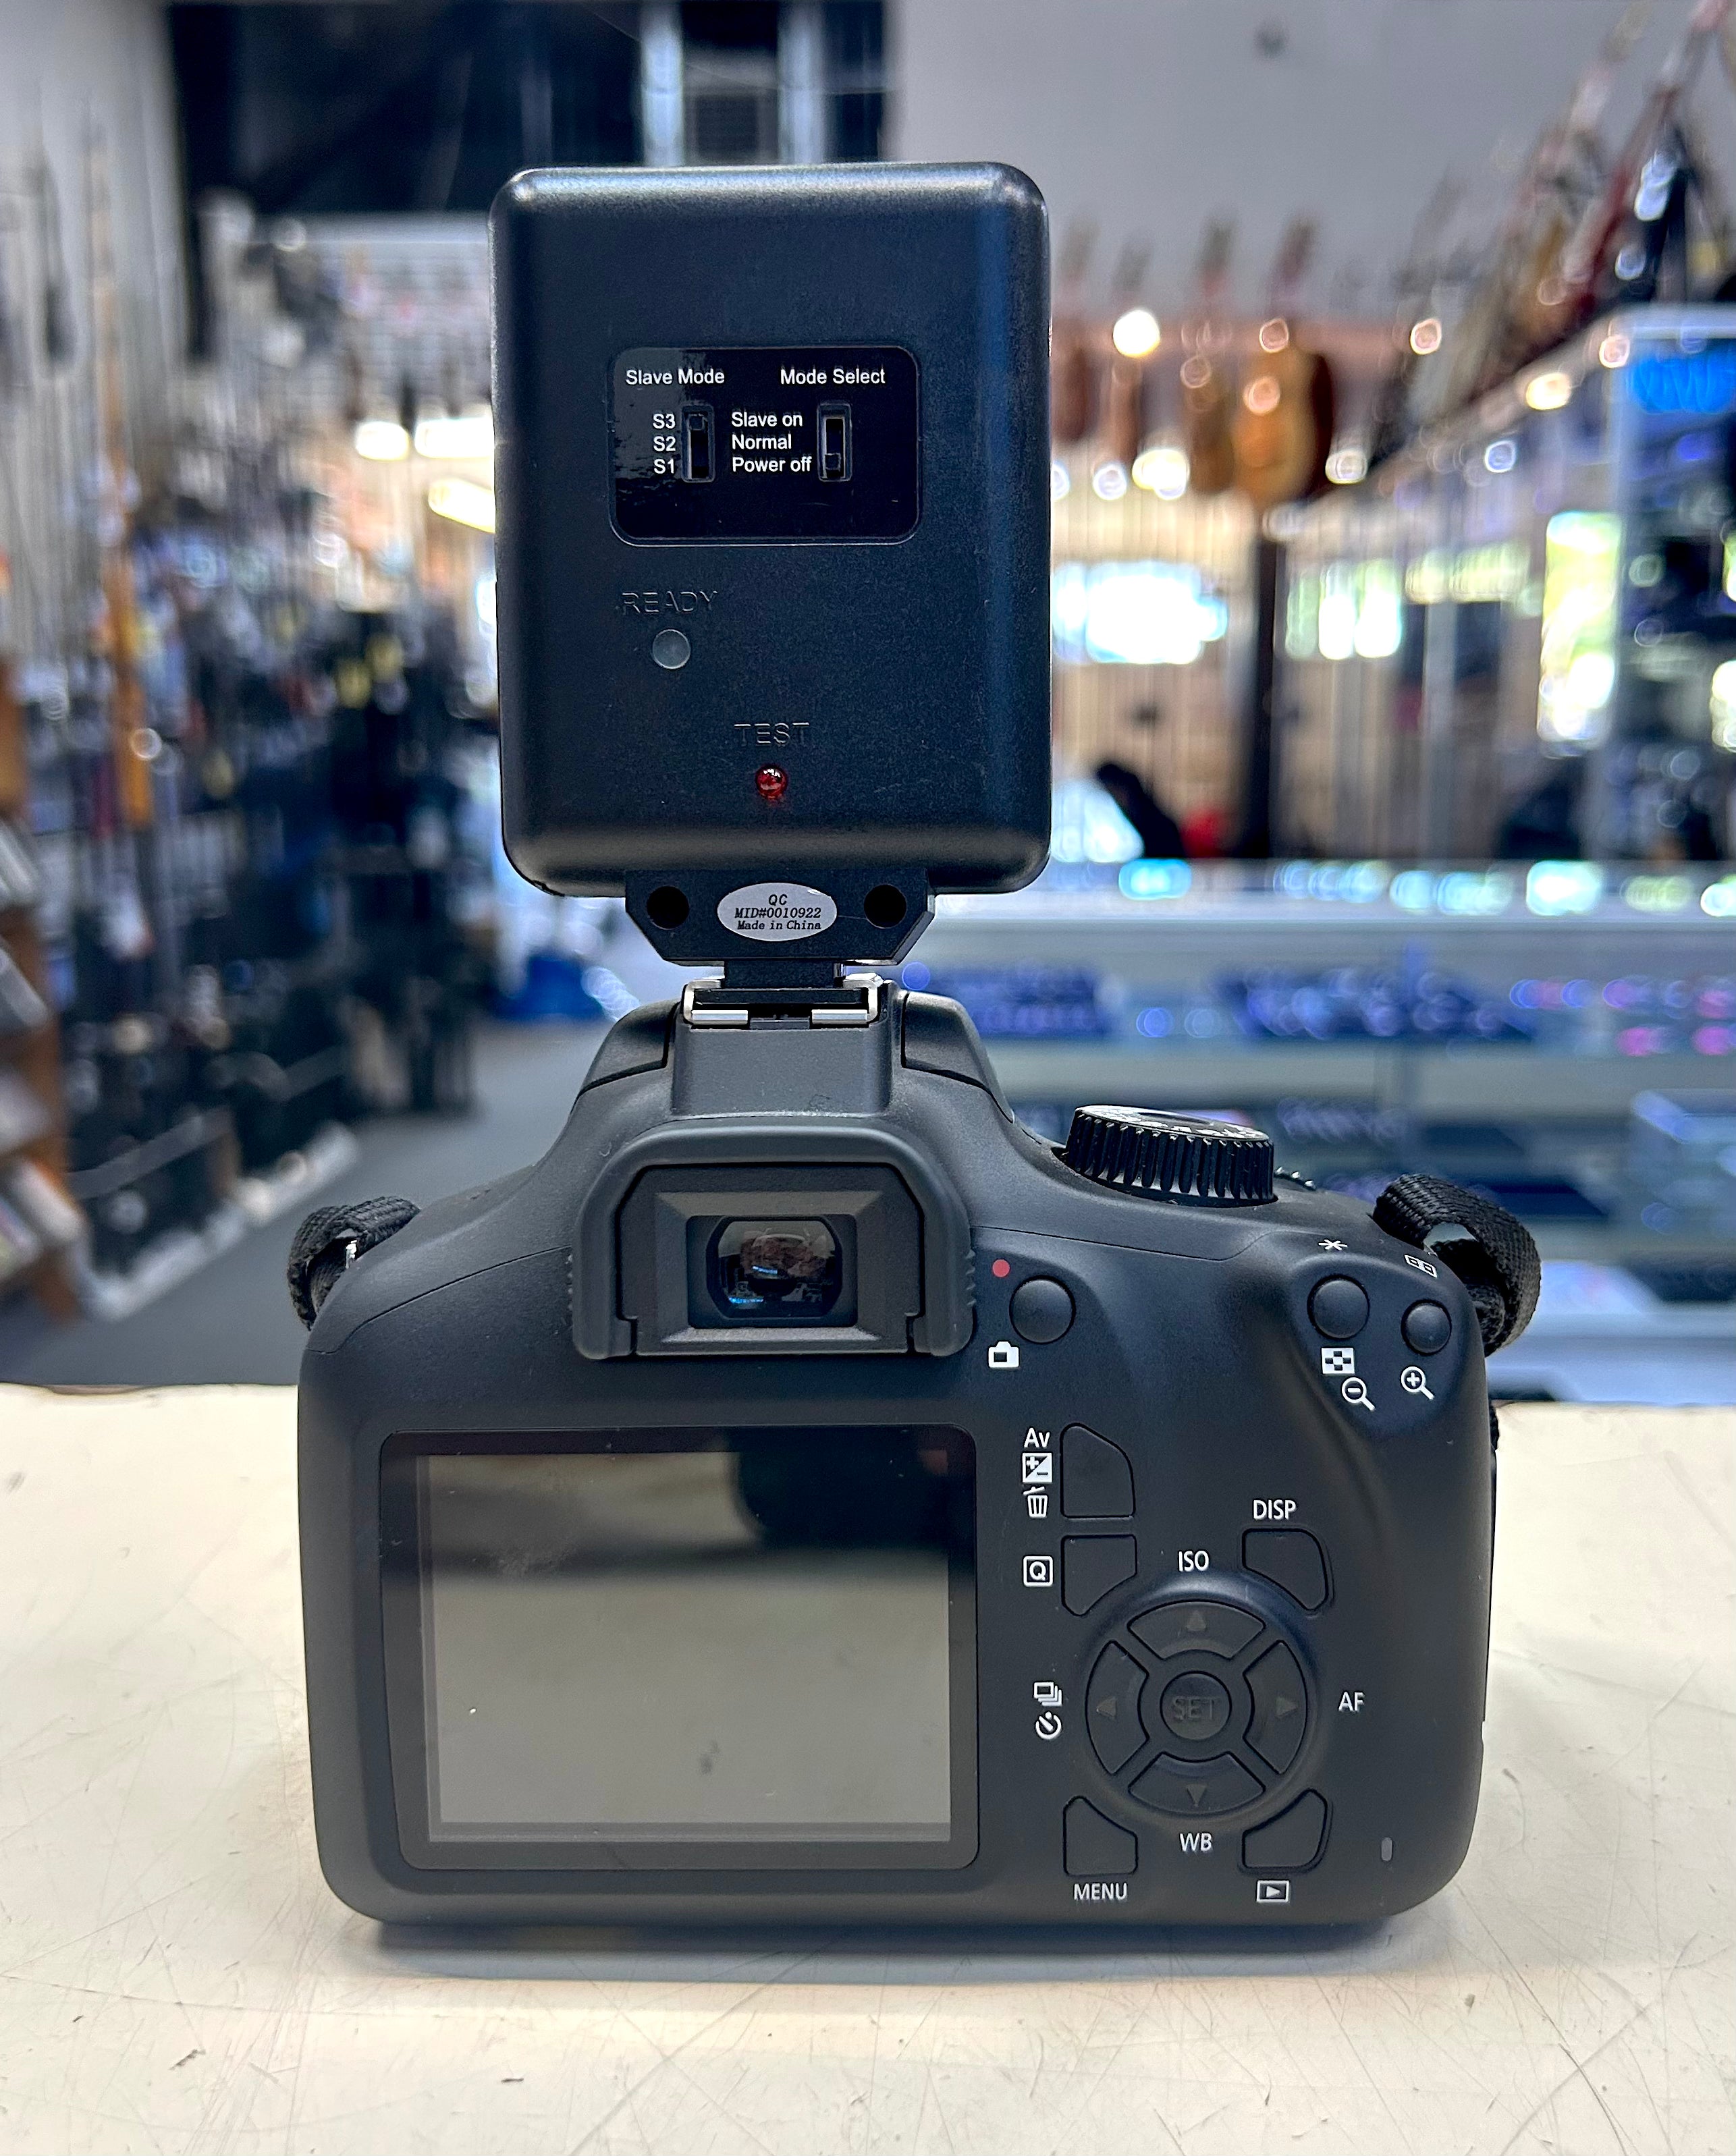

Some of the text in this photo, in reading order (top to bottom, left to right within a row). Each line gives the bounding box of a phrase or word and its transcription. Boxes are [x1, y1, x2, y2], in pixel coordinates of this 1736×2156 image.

[625, 368, 726, 385] Slave Mode
[780, 367, 886, 385] Mode Select
[652, 412, 676, 430] S3
[731, 411, 803, 427] Slave on
[653, 435, 676, 452] S2
[731, 433, 792, 449] Normal
[653, 458, 675, 474] S1
[732, 455, 813, 472] Power off
[621, 590, 717, 613] READY
[734, 721, 810, 745] TEST
[767, 893, 788, 906] QC
[734, 907, 822, 918] MID#0010922
[736, 920, 822, 930] Made in China
[1023, 1427, 1051, 1449] Av
[1253, 1499, 1297, 1520] DISP
[1178, 1549, 1210, 1572] ISO
[1173, 1695, 1218, 1720] SET
[1338, 1691, 1365, 1712] AF
[1179, 1832, 1213, 1852] WB
[1073, 1882, 1128, 1901] MENU
